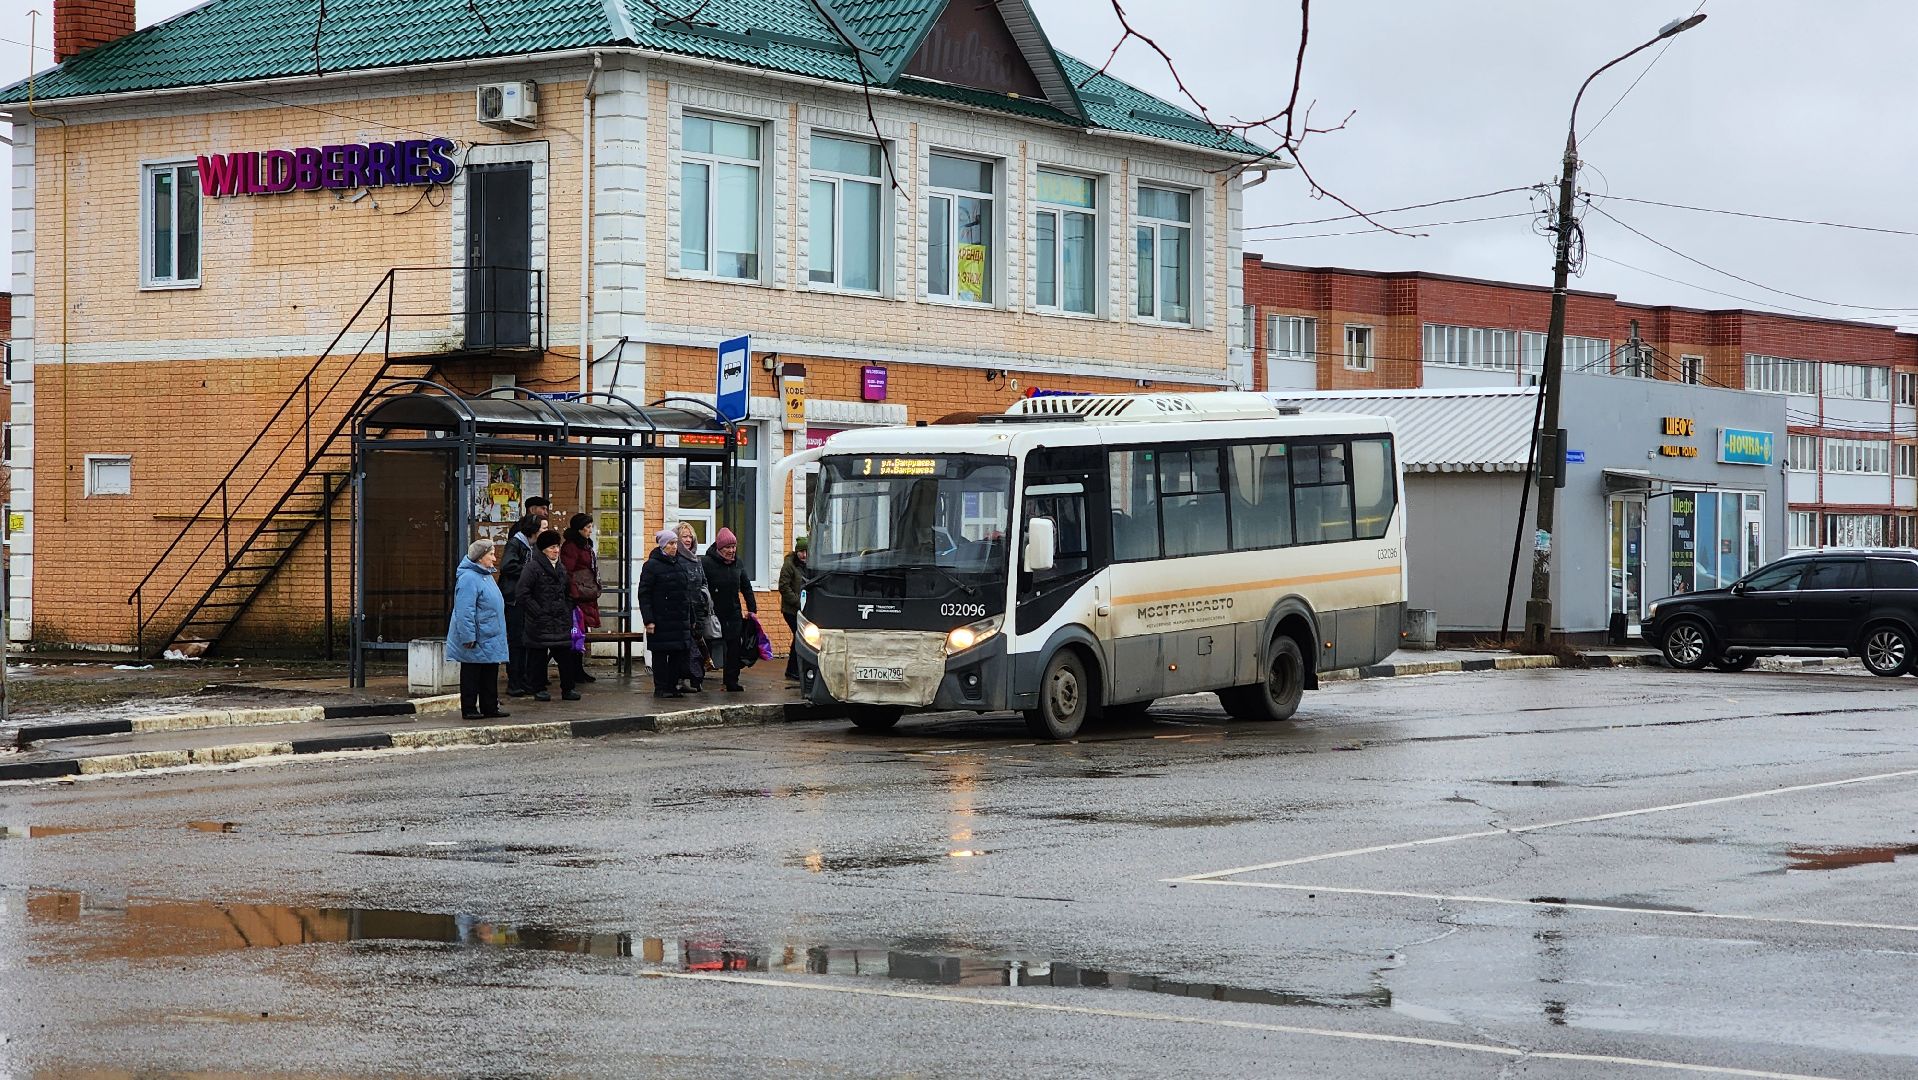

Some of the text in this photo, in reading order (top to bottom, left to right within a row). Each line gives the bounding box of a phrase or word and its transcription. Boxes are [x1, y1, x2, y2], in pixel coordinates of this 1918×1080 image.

[197, 137, 457, 198] WILDBERRIES
[958, 248, 983, 264] АРЕНДА
[785, 387, 804, 395] КОФЕ
[1729, 434, 1760, 455] НОЧКА
[863, 458, 872, 475] 3
[940, 603, 986, 616] 032096
[1137, 598, 1234, 619] МОСТРАНСАВТО
